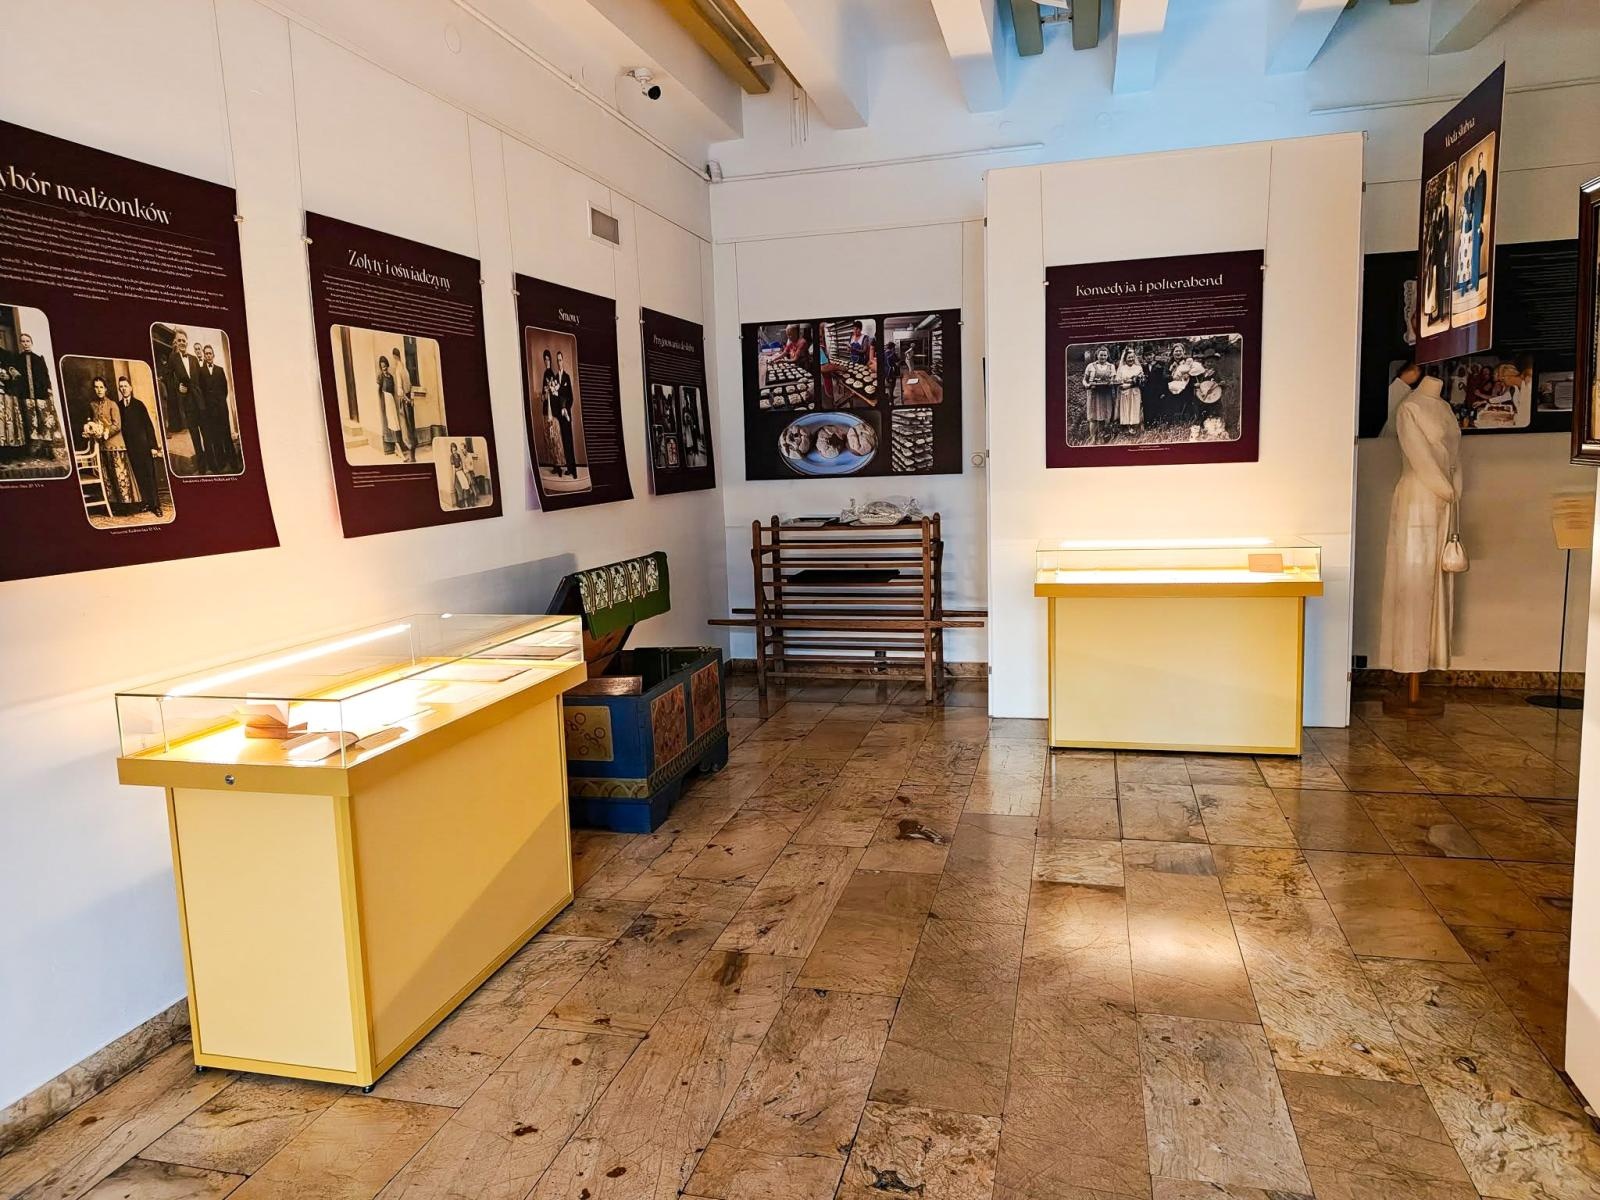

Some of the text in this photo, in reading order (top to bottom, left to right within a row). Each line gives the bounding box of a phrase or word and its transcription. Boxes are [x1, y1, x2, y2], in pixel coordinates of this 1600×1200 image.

[385, 260, 389, 274] i
[1076, 273, 1223, 297] Komedyja i polterabend
